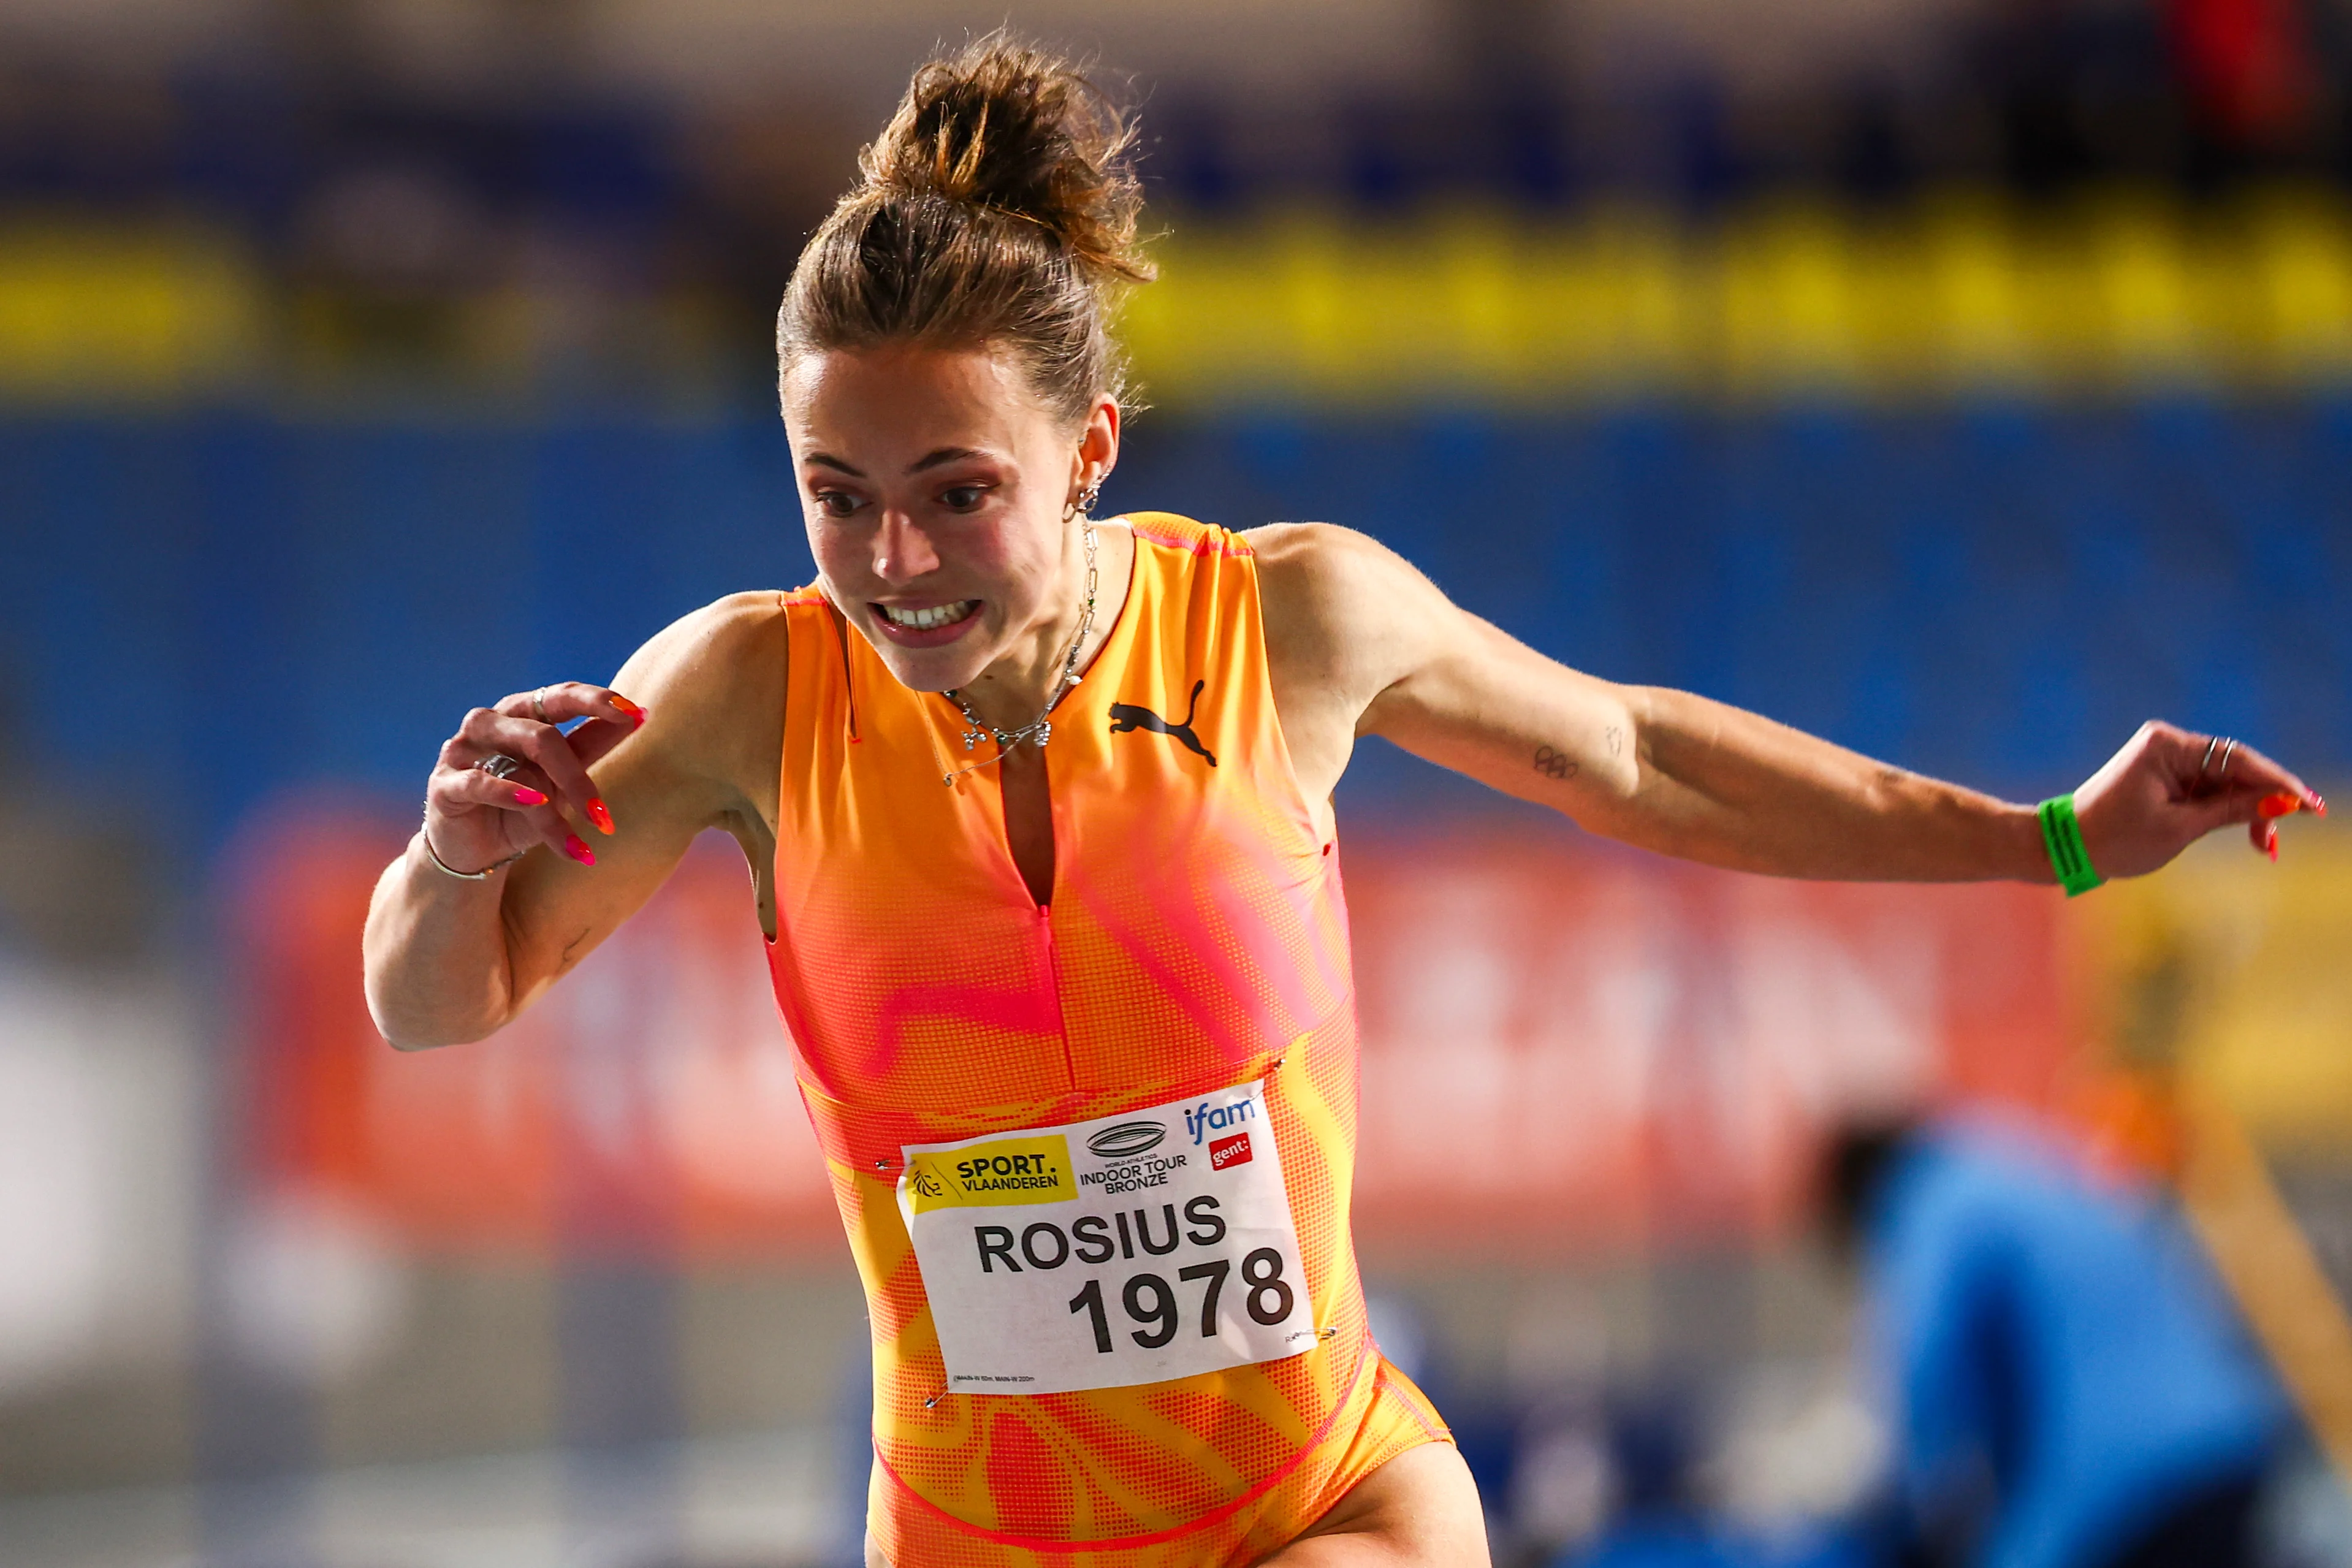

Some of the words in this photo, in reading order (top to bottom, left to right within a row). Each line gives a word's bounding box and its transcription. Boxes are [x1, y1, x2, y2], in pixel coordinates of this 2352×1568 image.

[1184, 1100, 1255, 1145] ifam
[957, 1154, 1056, 1178] SPORT.
[1212, 1140, 1249, 1166] gent:
[962, 1175, 1059, 1191] VLAANDEREN
[1080, 1165, 1142, 1186] INDOOR
[1144, 1155, 1187, 1174] TOUR
[1105, 1172, 1168, 1194] BRONZE
[974, 1195, 1227, 1273] ROSIUS
[1068, 1247, 1294, 1354] 1978
